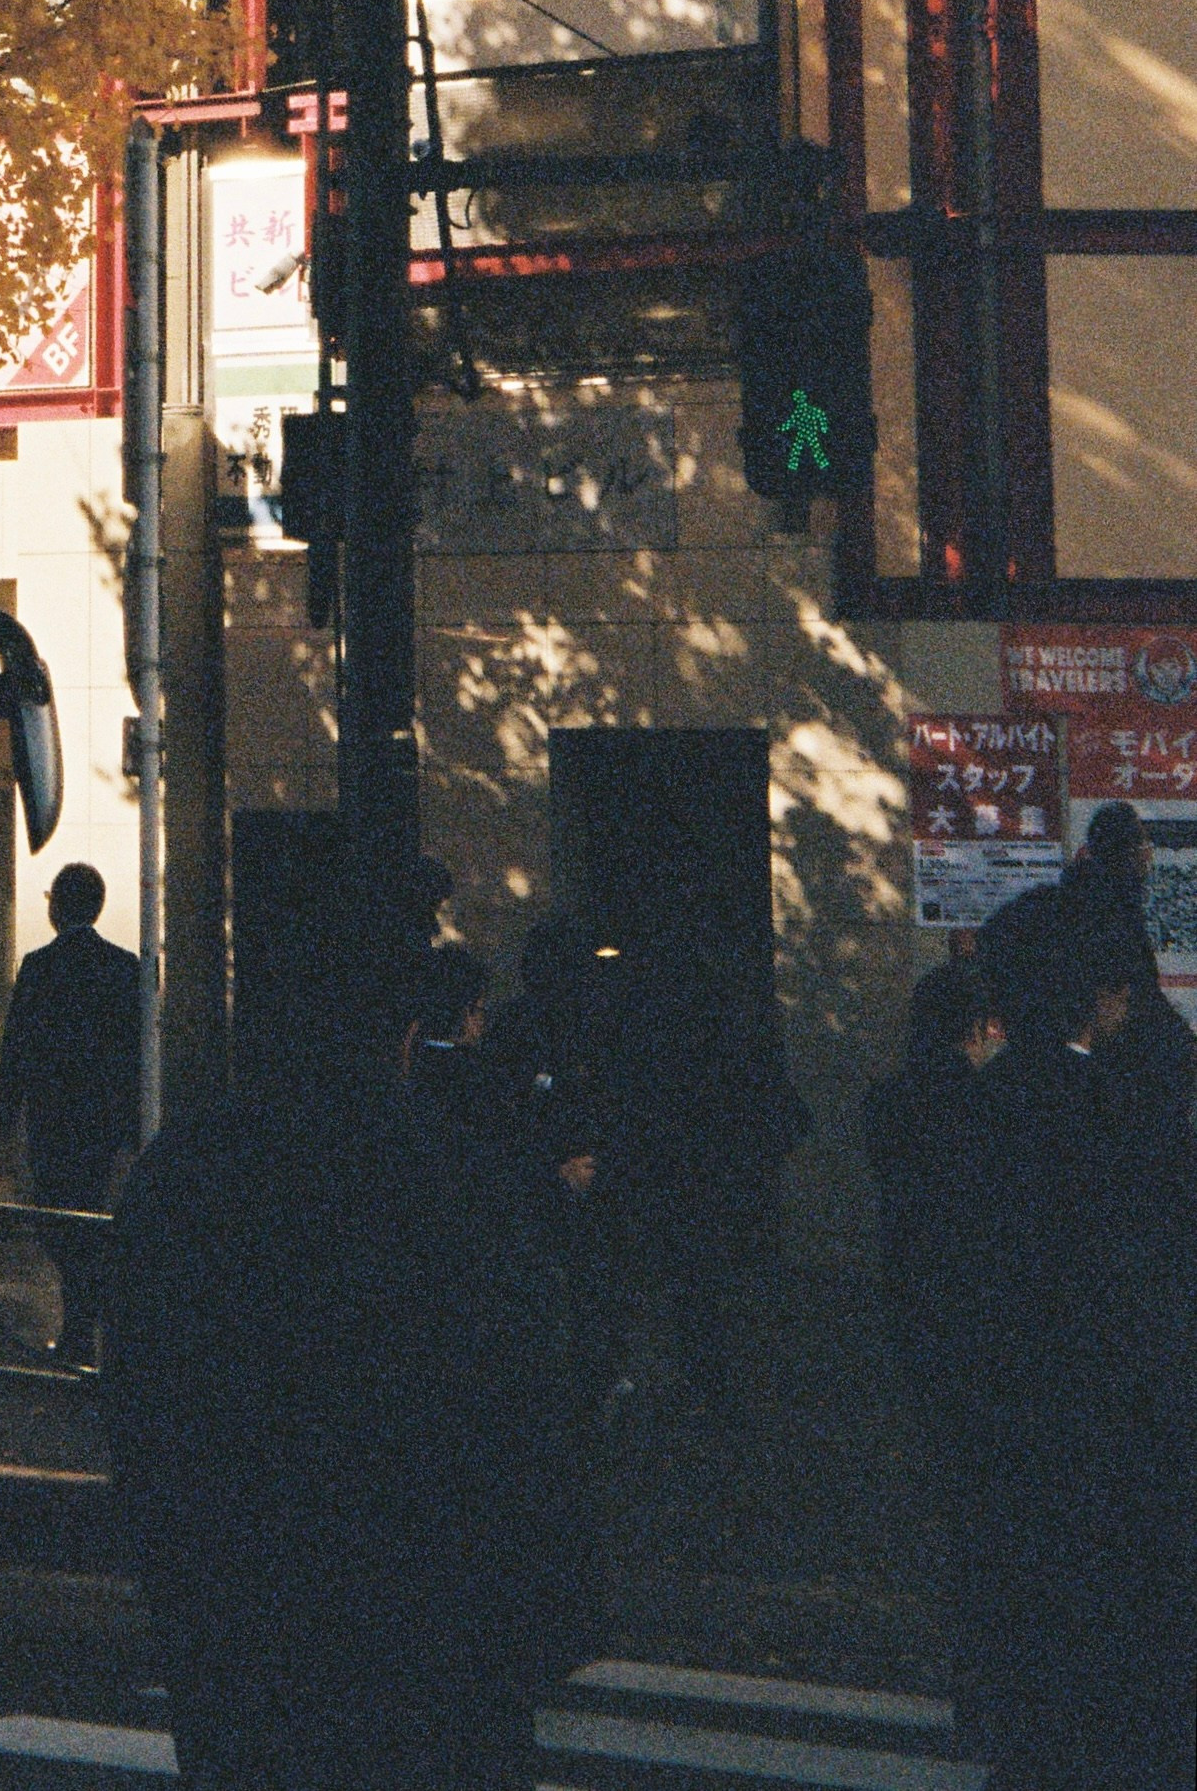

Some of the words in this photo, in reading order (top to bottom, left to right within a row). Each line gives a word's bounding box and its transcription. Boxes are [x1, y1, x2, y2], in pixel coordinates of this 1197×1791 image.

[1038, 646, 1127, 668] WELCOME
[1007, 668, 1129, 694] TRAVELERS
[936, 763, 1038, 794] スタッフ
